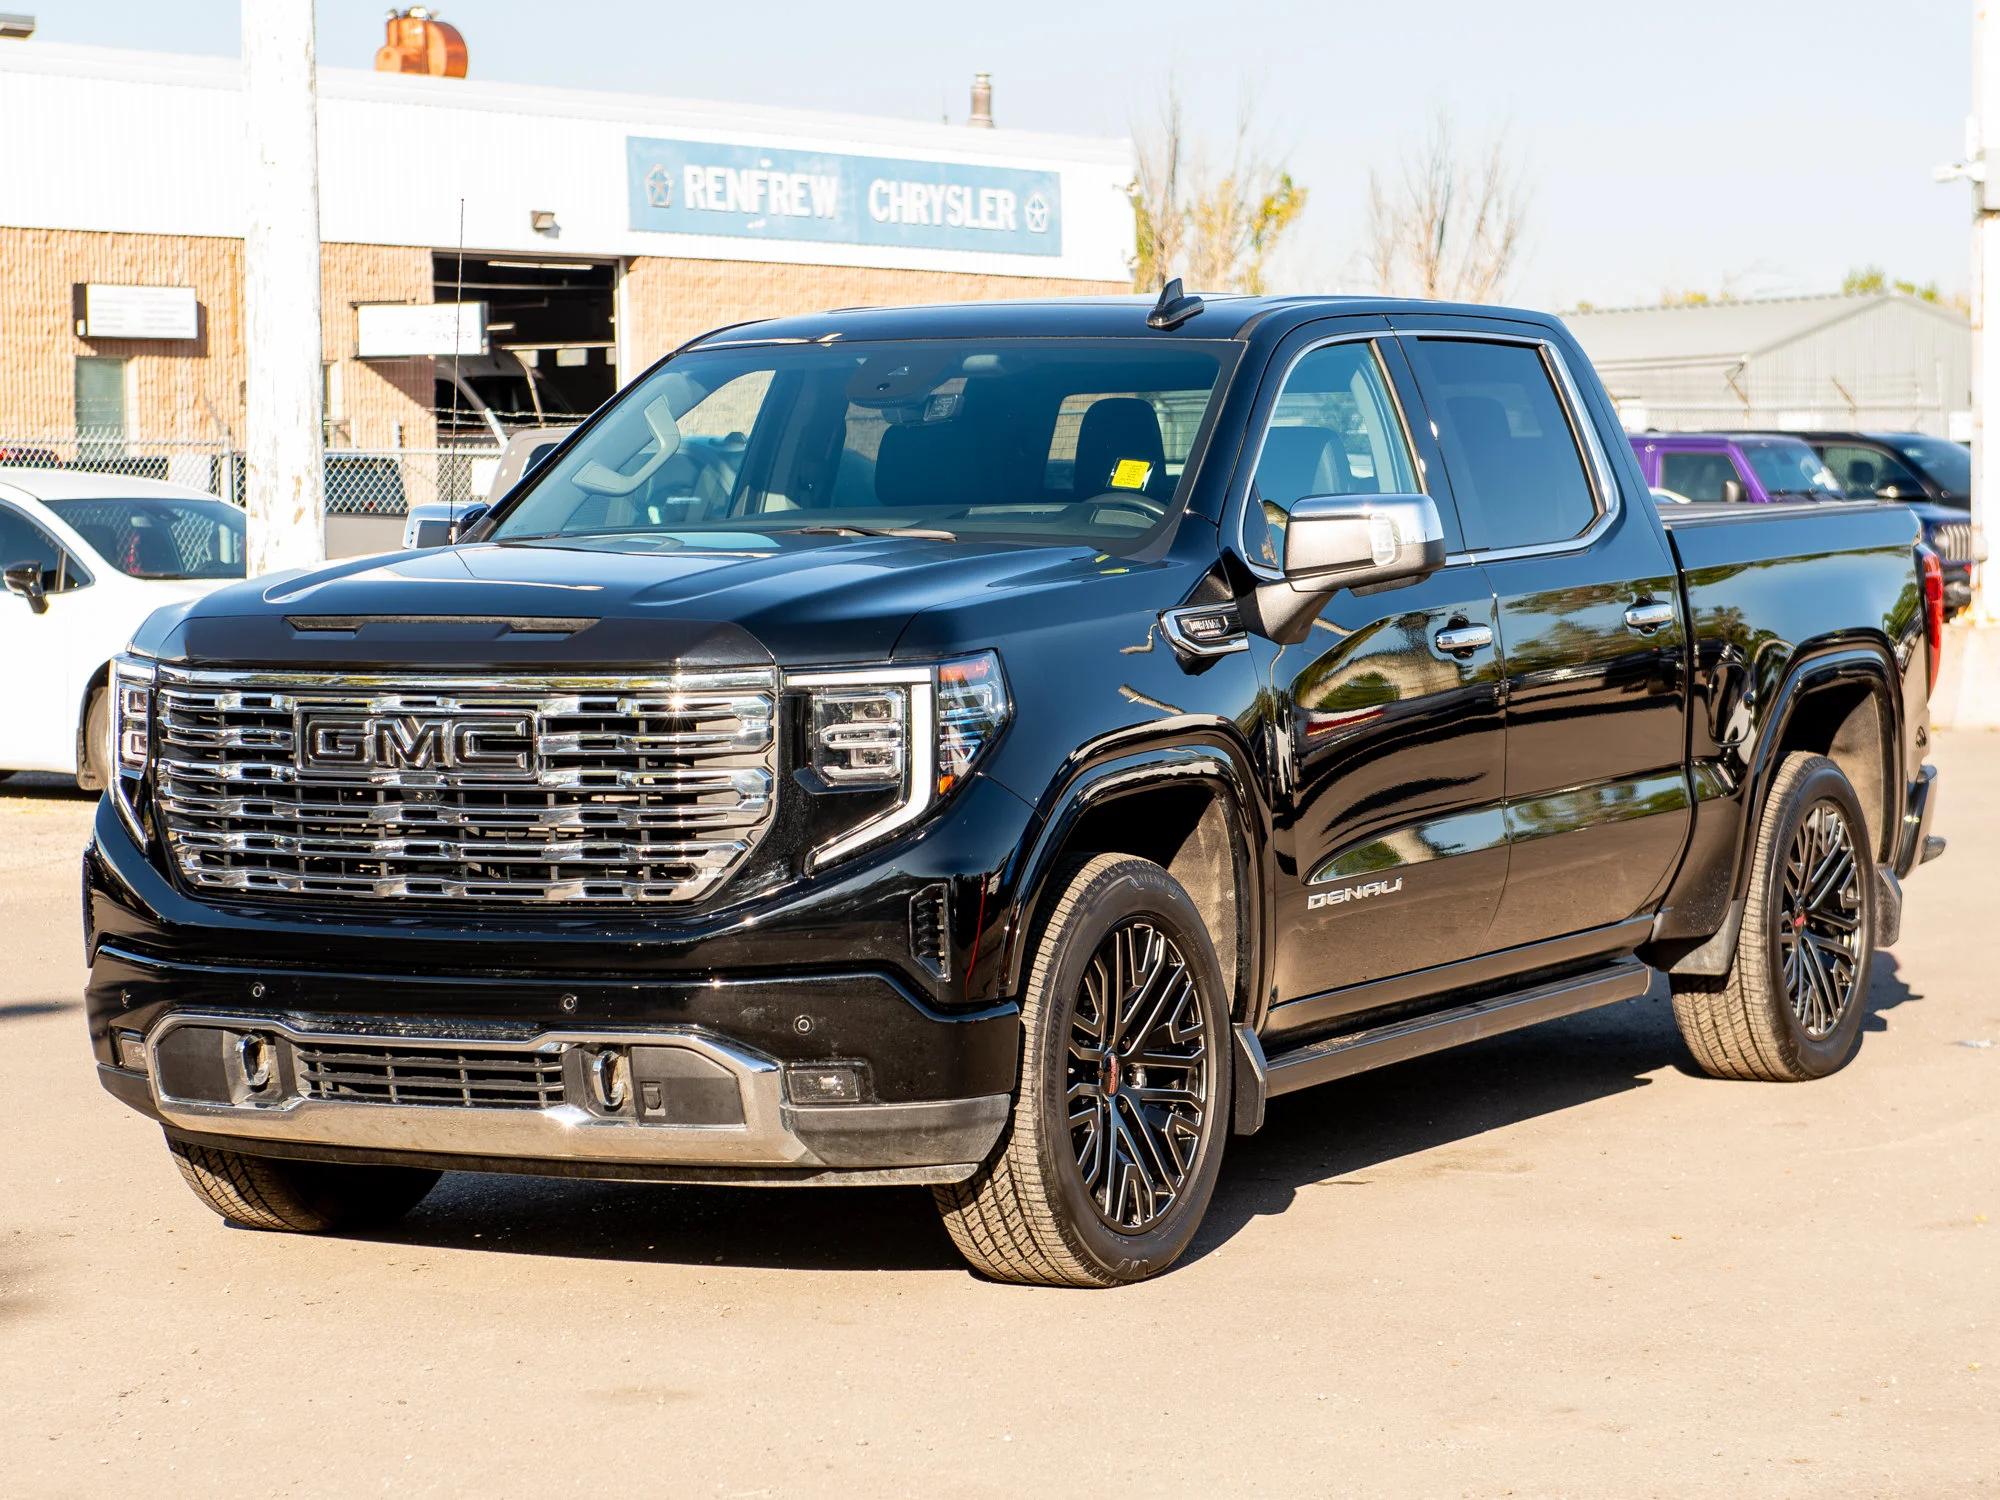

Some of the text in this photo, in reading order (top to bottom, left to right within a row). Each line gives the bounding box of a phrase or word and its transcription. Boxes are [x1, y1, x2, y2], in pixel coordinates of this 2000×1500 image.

[684, 165, 1017, 232] RENFREW CHRYSLER
[307, 716, 526, 768] GMC
[1308, 877, 1402, 910] DENALI
